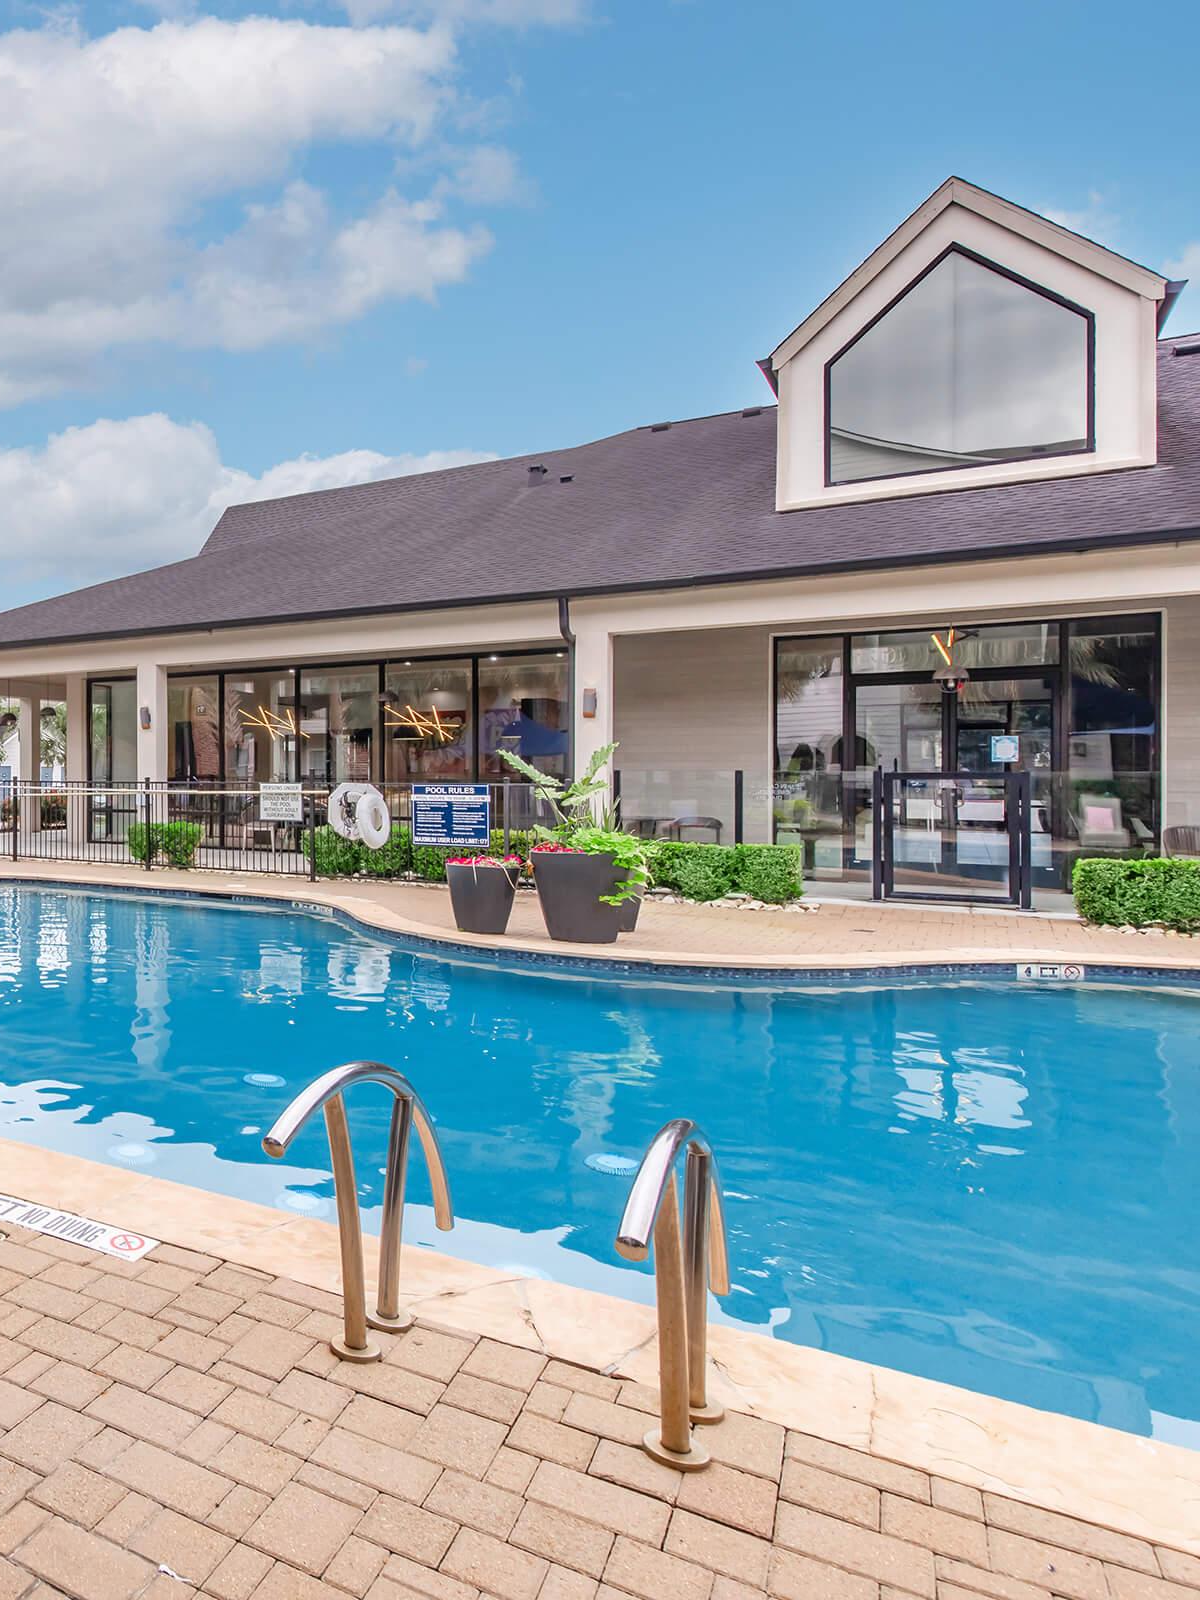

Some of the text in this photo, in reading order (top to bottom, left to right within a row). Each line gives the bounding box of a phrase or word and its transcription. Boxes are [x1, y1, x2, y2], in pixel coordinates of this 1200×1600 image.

[425, 786, 447, 794] POOL
[18, 1206, 50, 1225] NO
[43, 1215, 107, 1243] DIVING
